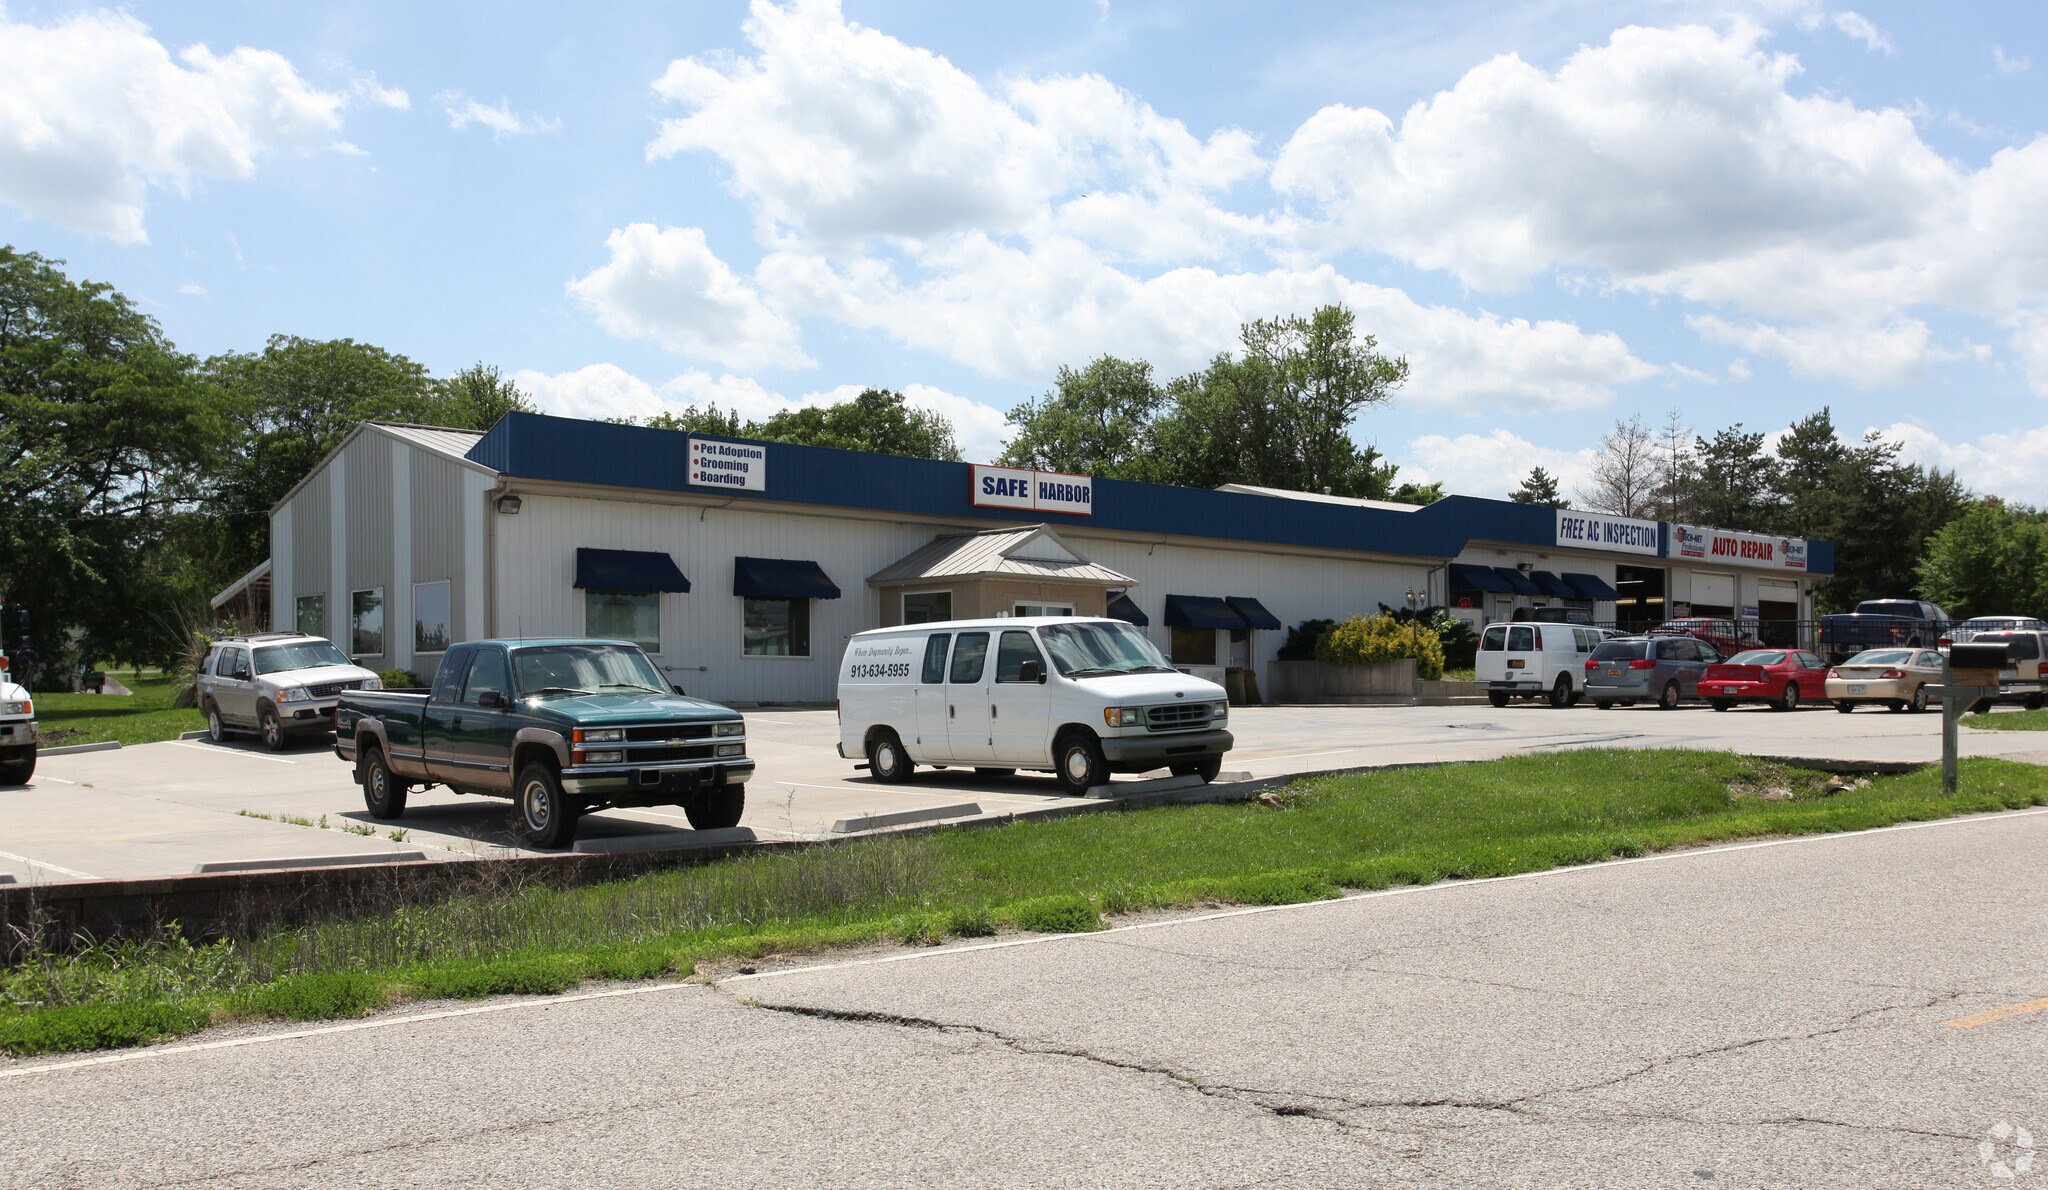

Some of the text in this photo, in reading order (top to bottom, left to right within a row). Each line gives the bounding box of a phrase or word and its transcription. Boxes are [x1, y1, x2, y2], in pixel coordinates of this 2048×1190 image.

[700, 443, 762, 459] Pet Adoption
[701, 457, 749, 473] Grooming
[700, 471, 745, 486] Boarding
[982, 476, 1090, 503] SAFE HARBOR
[1560, 517, 1656, 548] FREE AC INSPECTION
[1711, 536, 1773, 561] AUTO REPAIR
[851, 663, 910, 678] 913-634-5955
